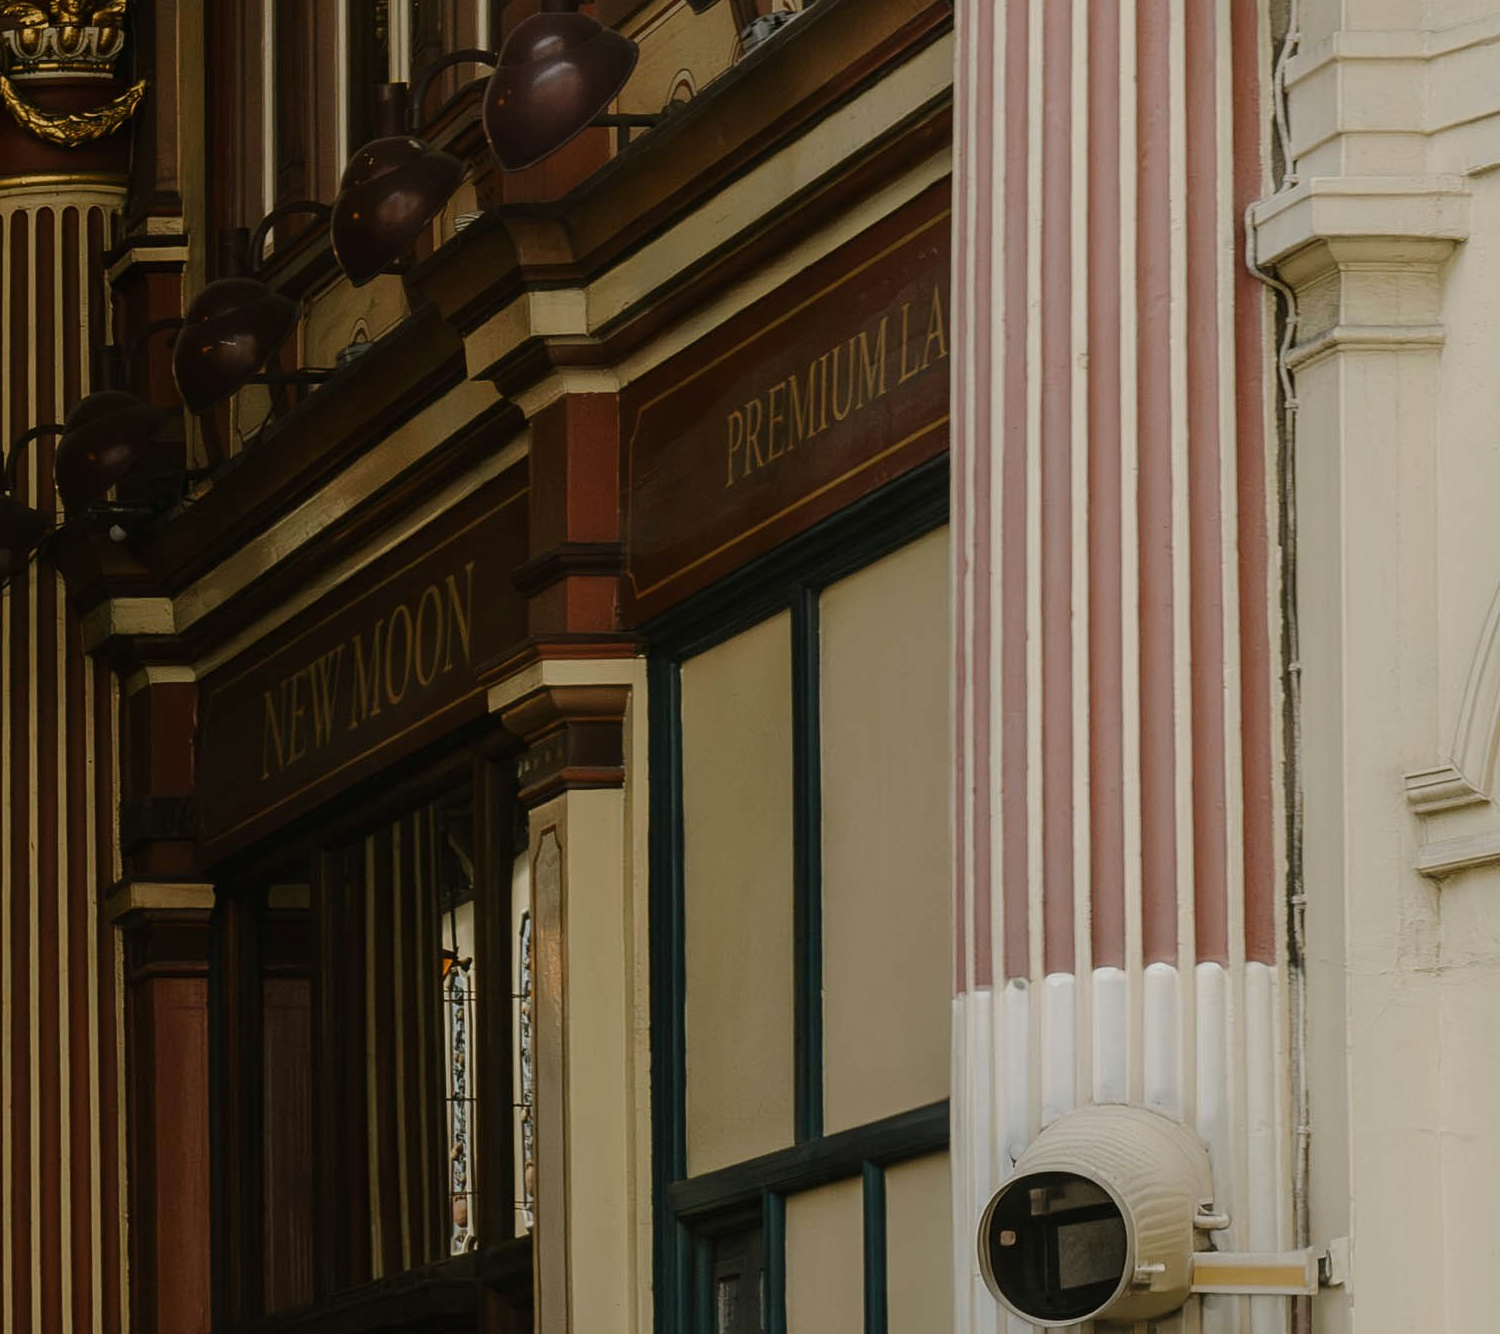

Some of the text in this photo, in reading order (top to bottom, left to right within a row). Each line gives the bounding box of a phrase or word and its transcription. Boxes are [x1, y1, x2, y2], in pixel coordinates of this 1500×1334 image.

[724, 330, 888, 491] PREMIUM
[261, 561, 476, 780] NEW MOON
